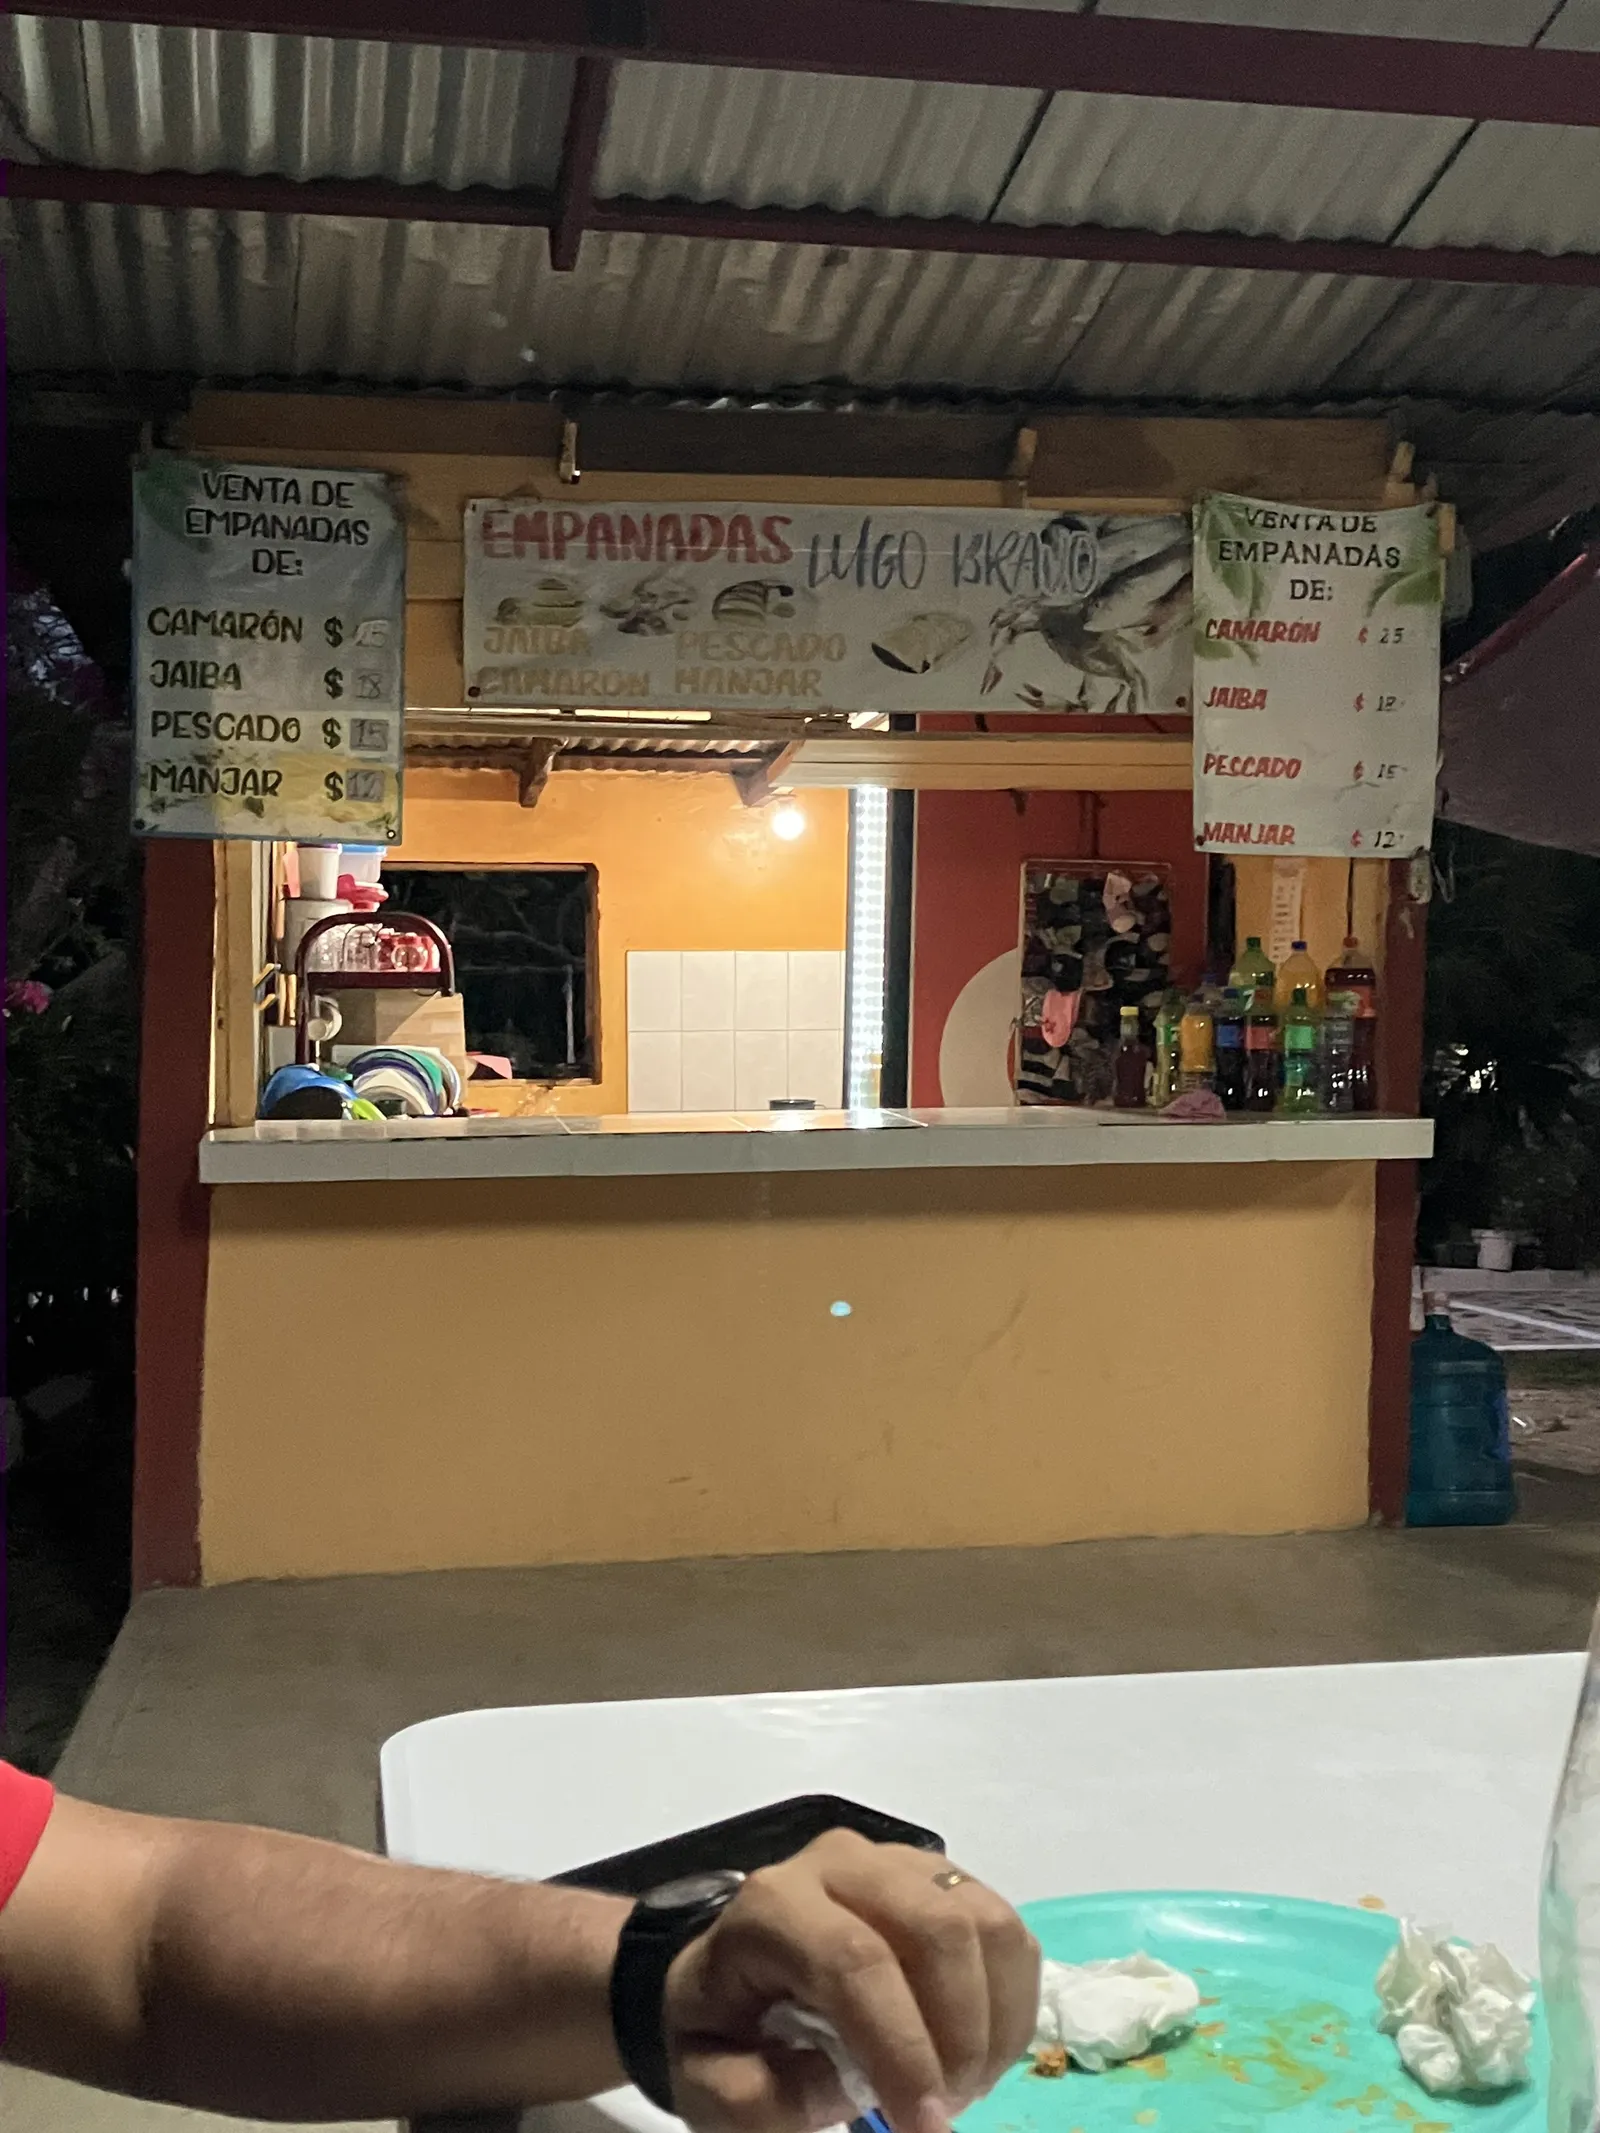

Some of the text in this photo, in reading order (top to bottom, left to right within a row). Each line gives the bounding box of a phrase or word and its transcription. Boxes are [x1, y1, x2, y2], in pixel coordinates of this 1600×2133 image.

[202, 473, 355, 508] VENTA DE
[185, 508, 371, 546] EMPANADAS
[1245, 506, 1377, 532] VENTA DE
[484, 509, 794, 565] EMPANADAS
[1219, 540, 1400, 568] EMPANADAS
[147, 606, 303, 643] CAMARÓN
[324, 615, 344, 648] $
[676, 630, 847, 663] PESCADO
[148, 660, 243, 691] JAIBA
[323, 667, 344, 699] $
[674, 666, 824, 698] MANJAR
[1204, 687, 1268, 710] JAIBA
[151, 711, 301, 744] PESCADO
[322, 717, 342, 750] $
[149, 766, 283, 797] MANJAR
[324, 770, 344, 802] $
[1203, 822, 1296, 845] MANJAR
